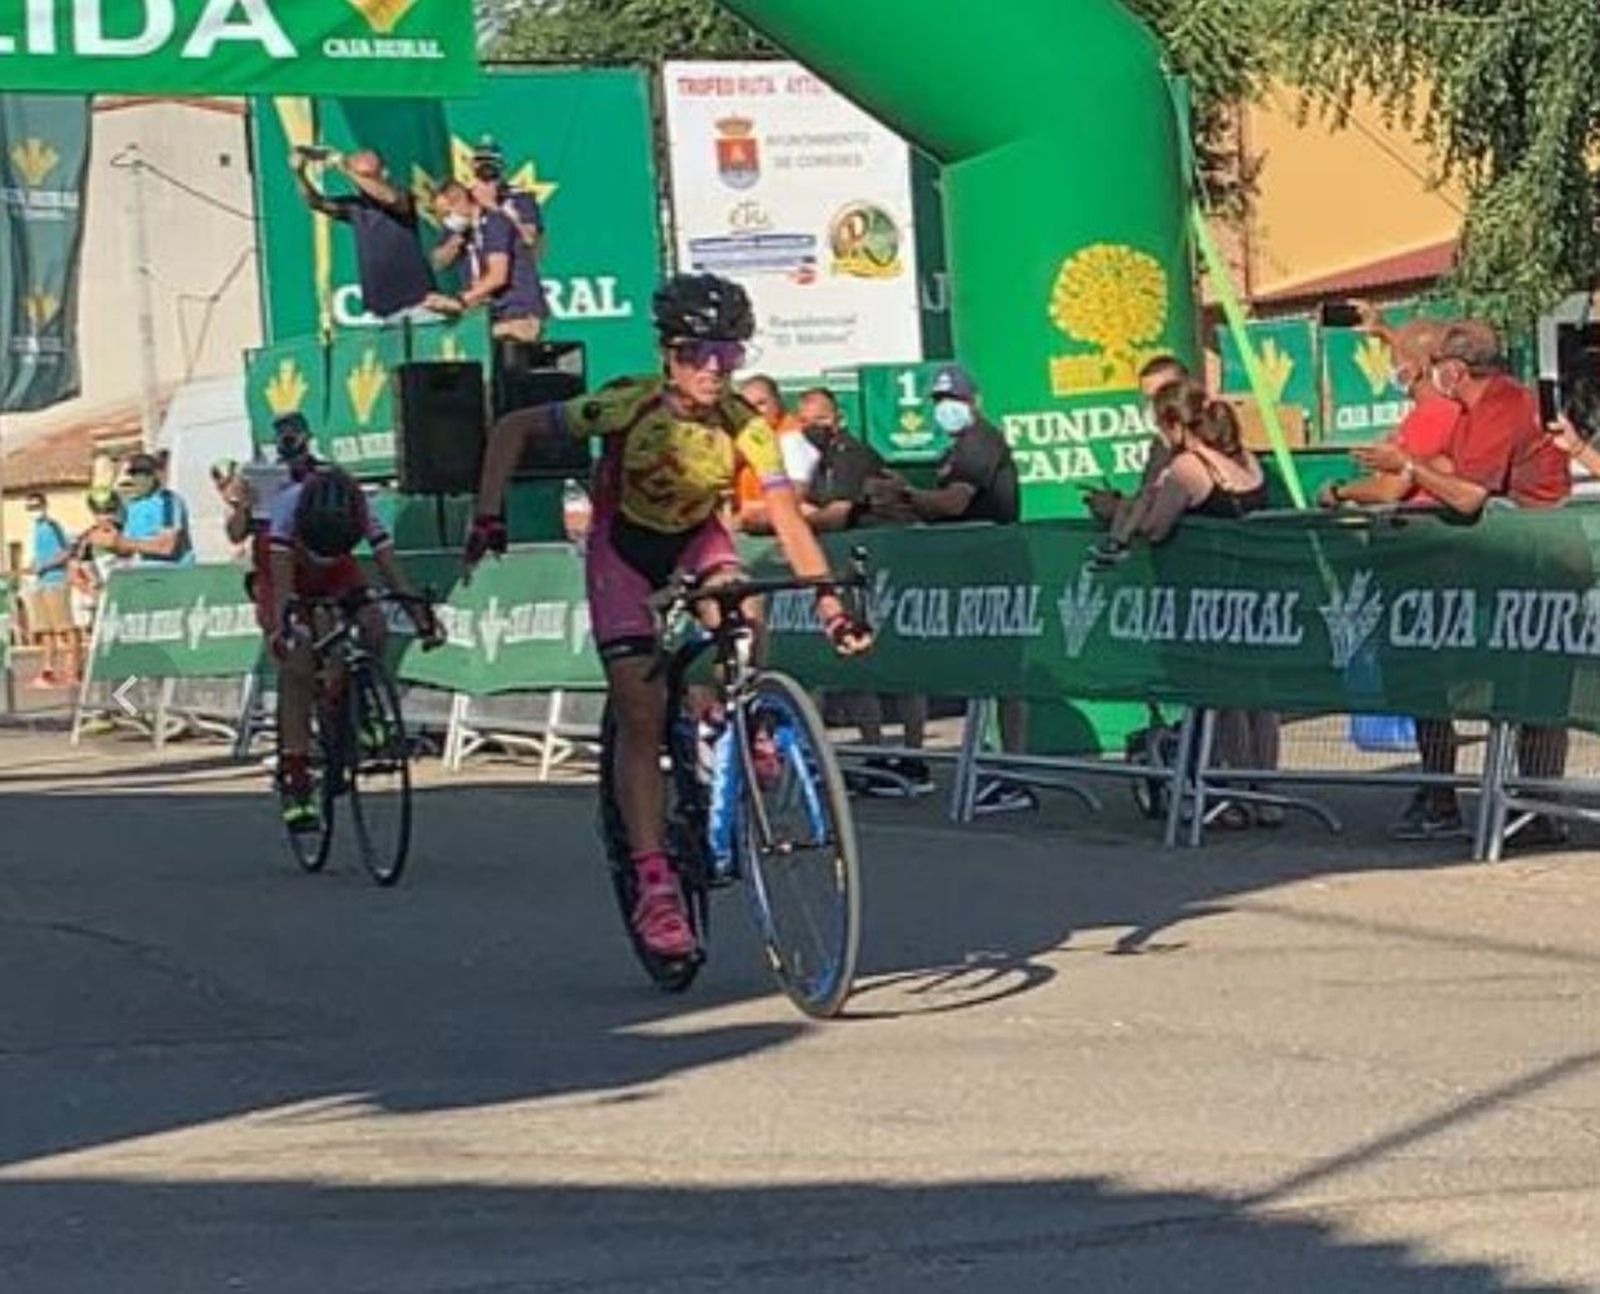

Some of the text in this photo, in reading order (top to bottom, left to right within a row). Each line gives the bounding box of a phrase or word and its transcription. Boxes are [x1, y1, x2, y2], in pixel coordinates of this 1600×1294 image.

[0, 0, 299, 58] IDA
[541, 276, 632, 318] RAL
[898, 368, 922, 405] 1
[895, 585, 1044, 638] CAJA RURAL
[1110, 586, 1304, 645] CAJA RURAL
[1389, 587, 1477, 650] CAJA
